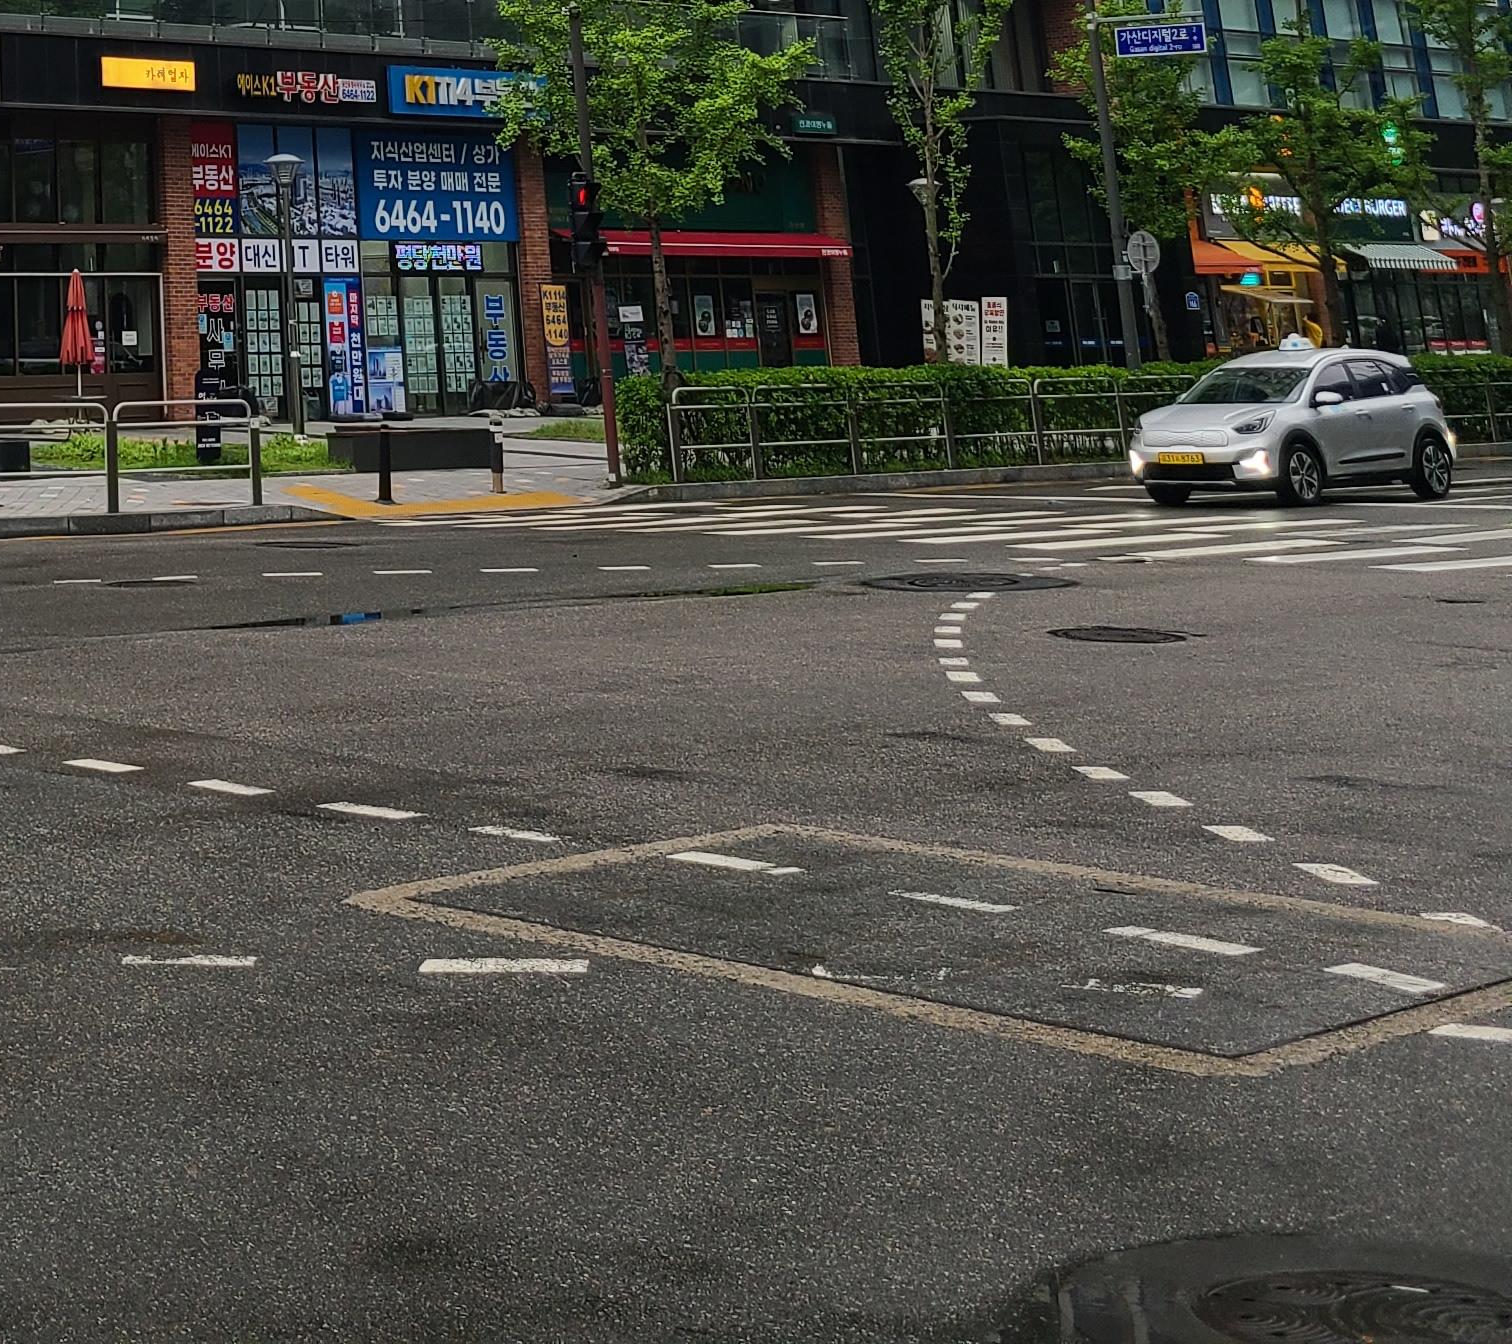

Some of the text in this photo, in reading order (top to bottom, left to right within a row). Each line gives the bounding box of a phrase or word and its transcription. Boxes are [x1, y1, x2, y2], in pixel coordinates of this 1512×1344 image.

[1120, 28, 1189, 44] 가산디지털2로
[370, 141, 455, 164] 지식산업센터
[472, 144, 500, 165] 상가
[192, 165, 234, 191] 부동산
[373, 169, 501, 193] 투자 분양 매매 전문
[194, 199, 233, 215] 6464
[375, 199, 506, 234] 6464-1140
[1364, 199, 1408, 218] BURGER
[194, 217, 234, 233] -1122
[195, 242, 236, 271] 분양
[245, 244, 277, 269] 대신
[325, 244, 356, 270] 타워
[197, 294, 235, 312] 부동산
[546, 315, 568, 325] 6464
